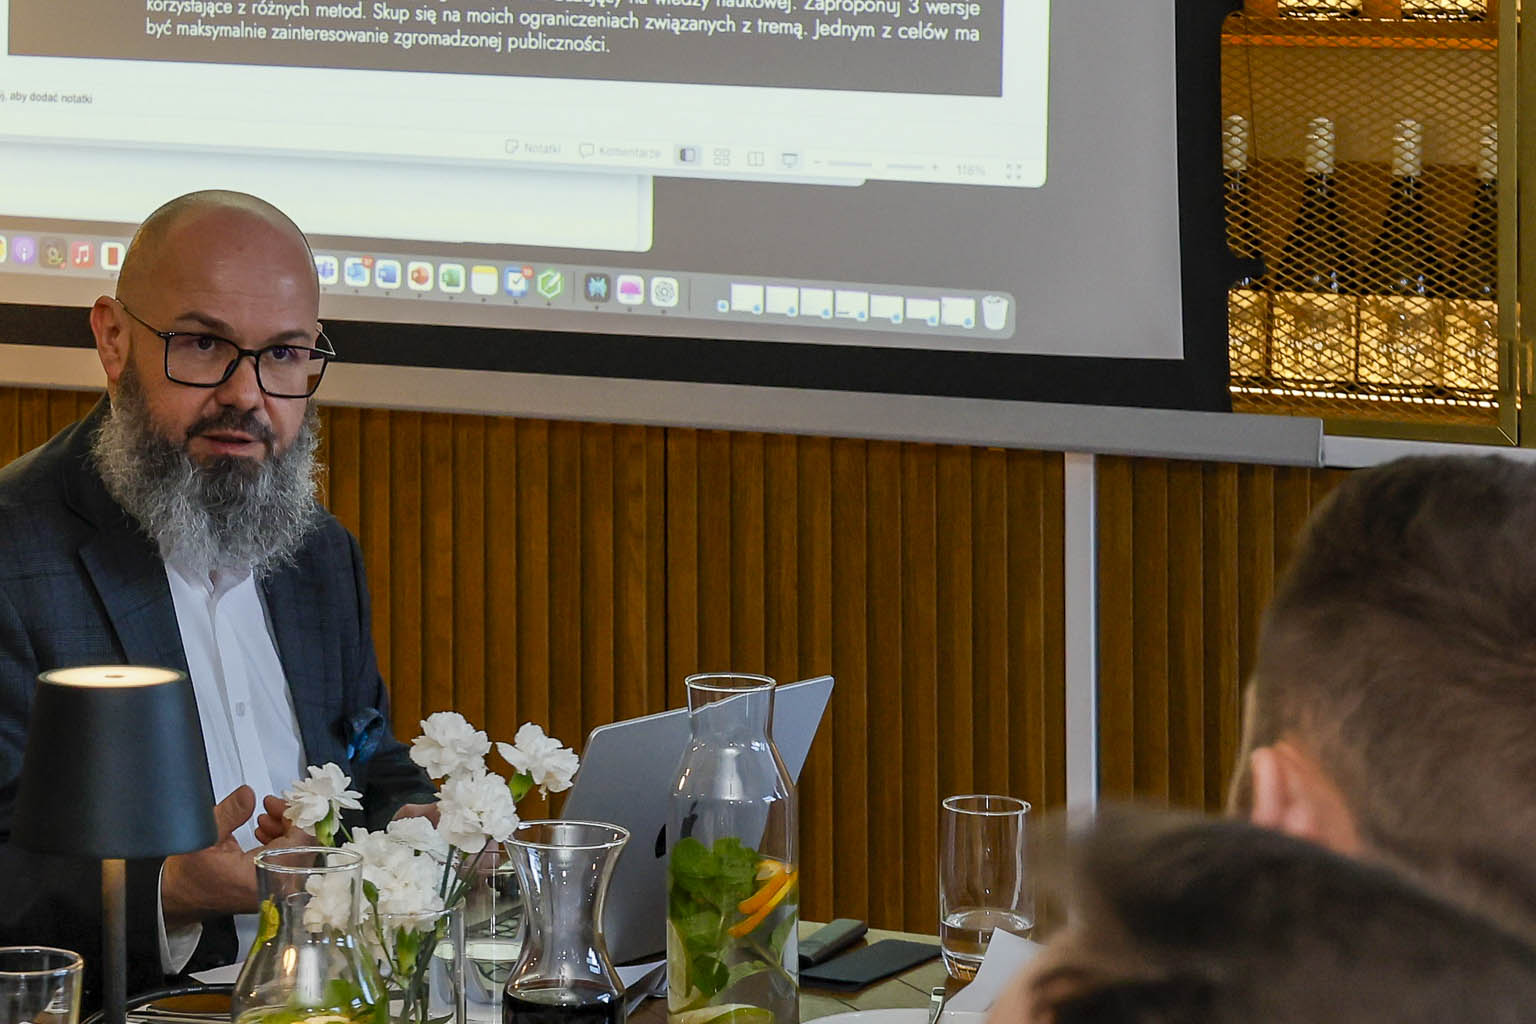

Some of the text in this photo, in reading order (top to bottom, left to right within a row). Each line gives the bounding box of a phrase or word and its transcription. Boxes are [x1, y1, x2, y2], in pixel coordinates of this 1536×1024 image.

[8, 90, 28, 104] aby
[28, 91, 58, 103] dodać
[60, 93, 93, 104] notatki
